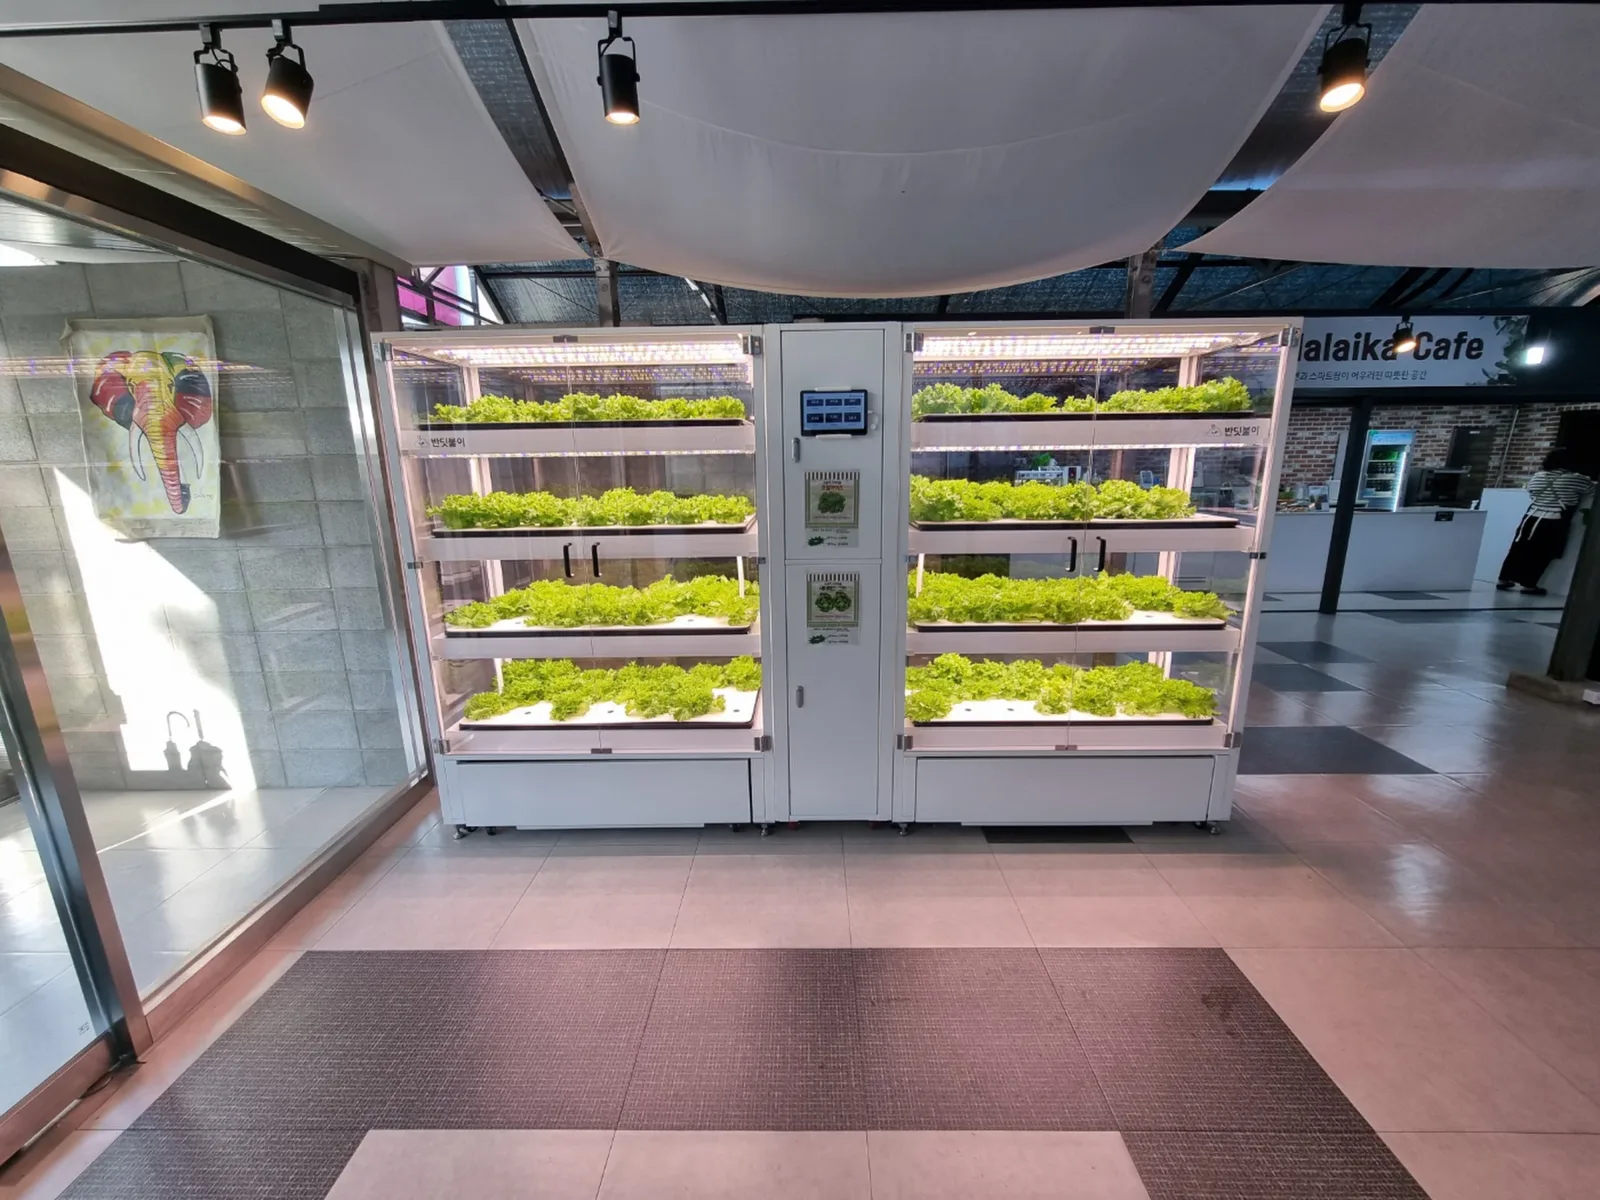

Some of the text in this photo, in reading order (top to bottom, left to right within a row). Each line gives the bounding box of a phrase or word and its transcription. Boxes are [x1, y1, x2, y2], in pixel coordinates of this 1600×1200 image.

[1413, 331, 1484, 360] Cafe
[1351, 370, 1383, 381] 어우러진
[1385, 370, 1409, 380] 따뜻한
[1411, 370, 1427, 380] 공간
[1225, 426, 1260, 437] 반딧불이
[431, 437, 466, 448] 반딧불이
